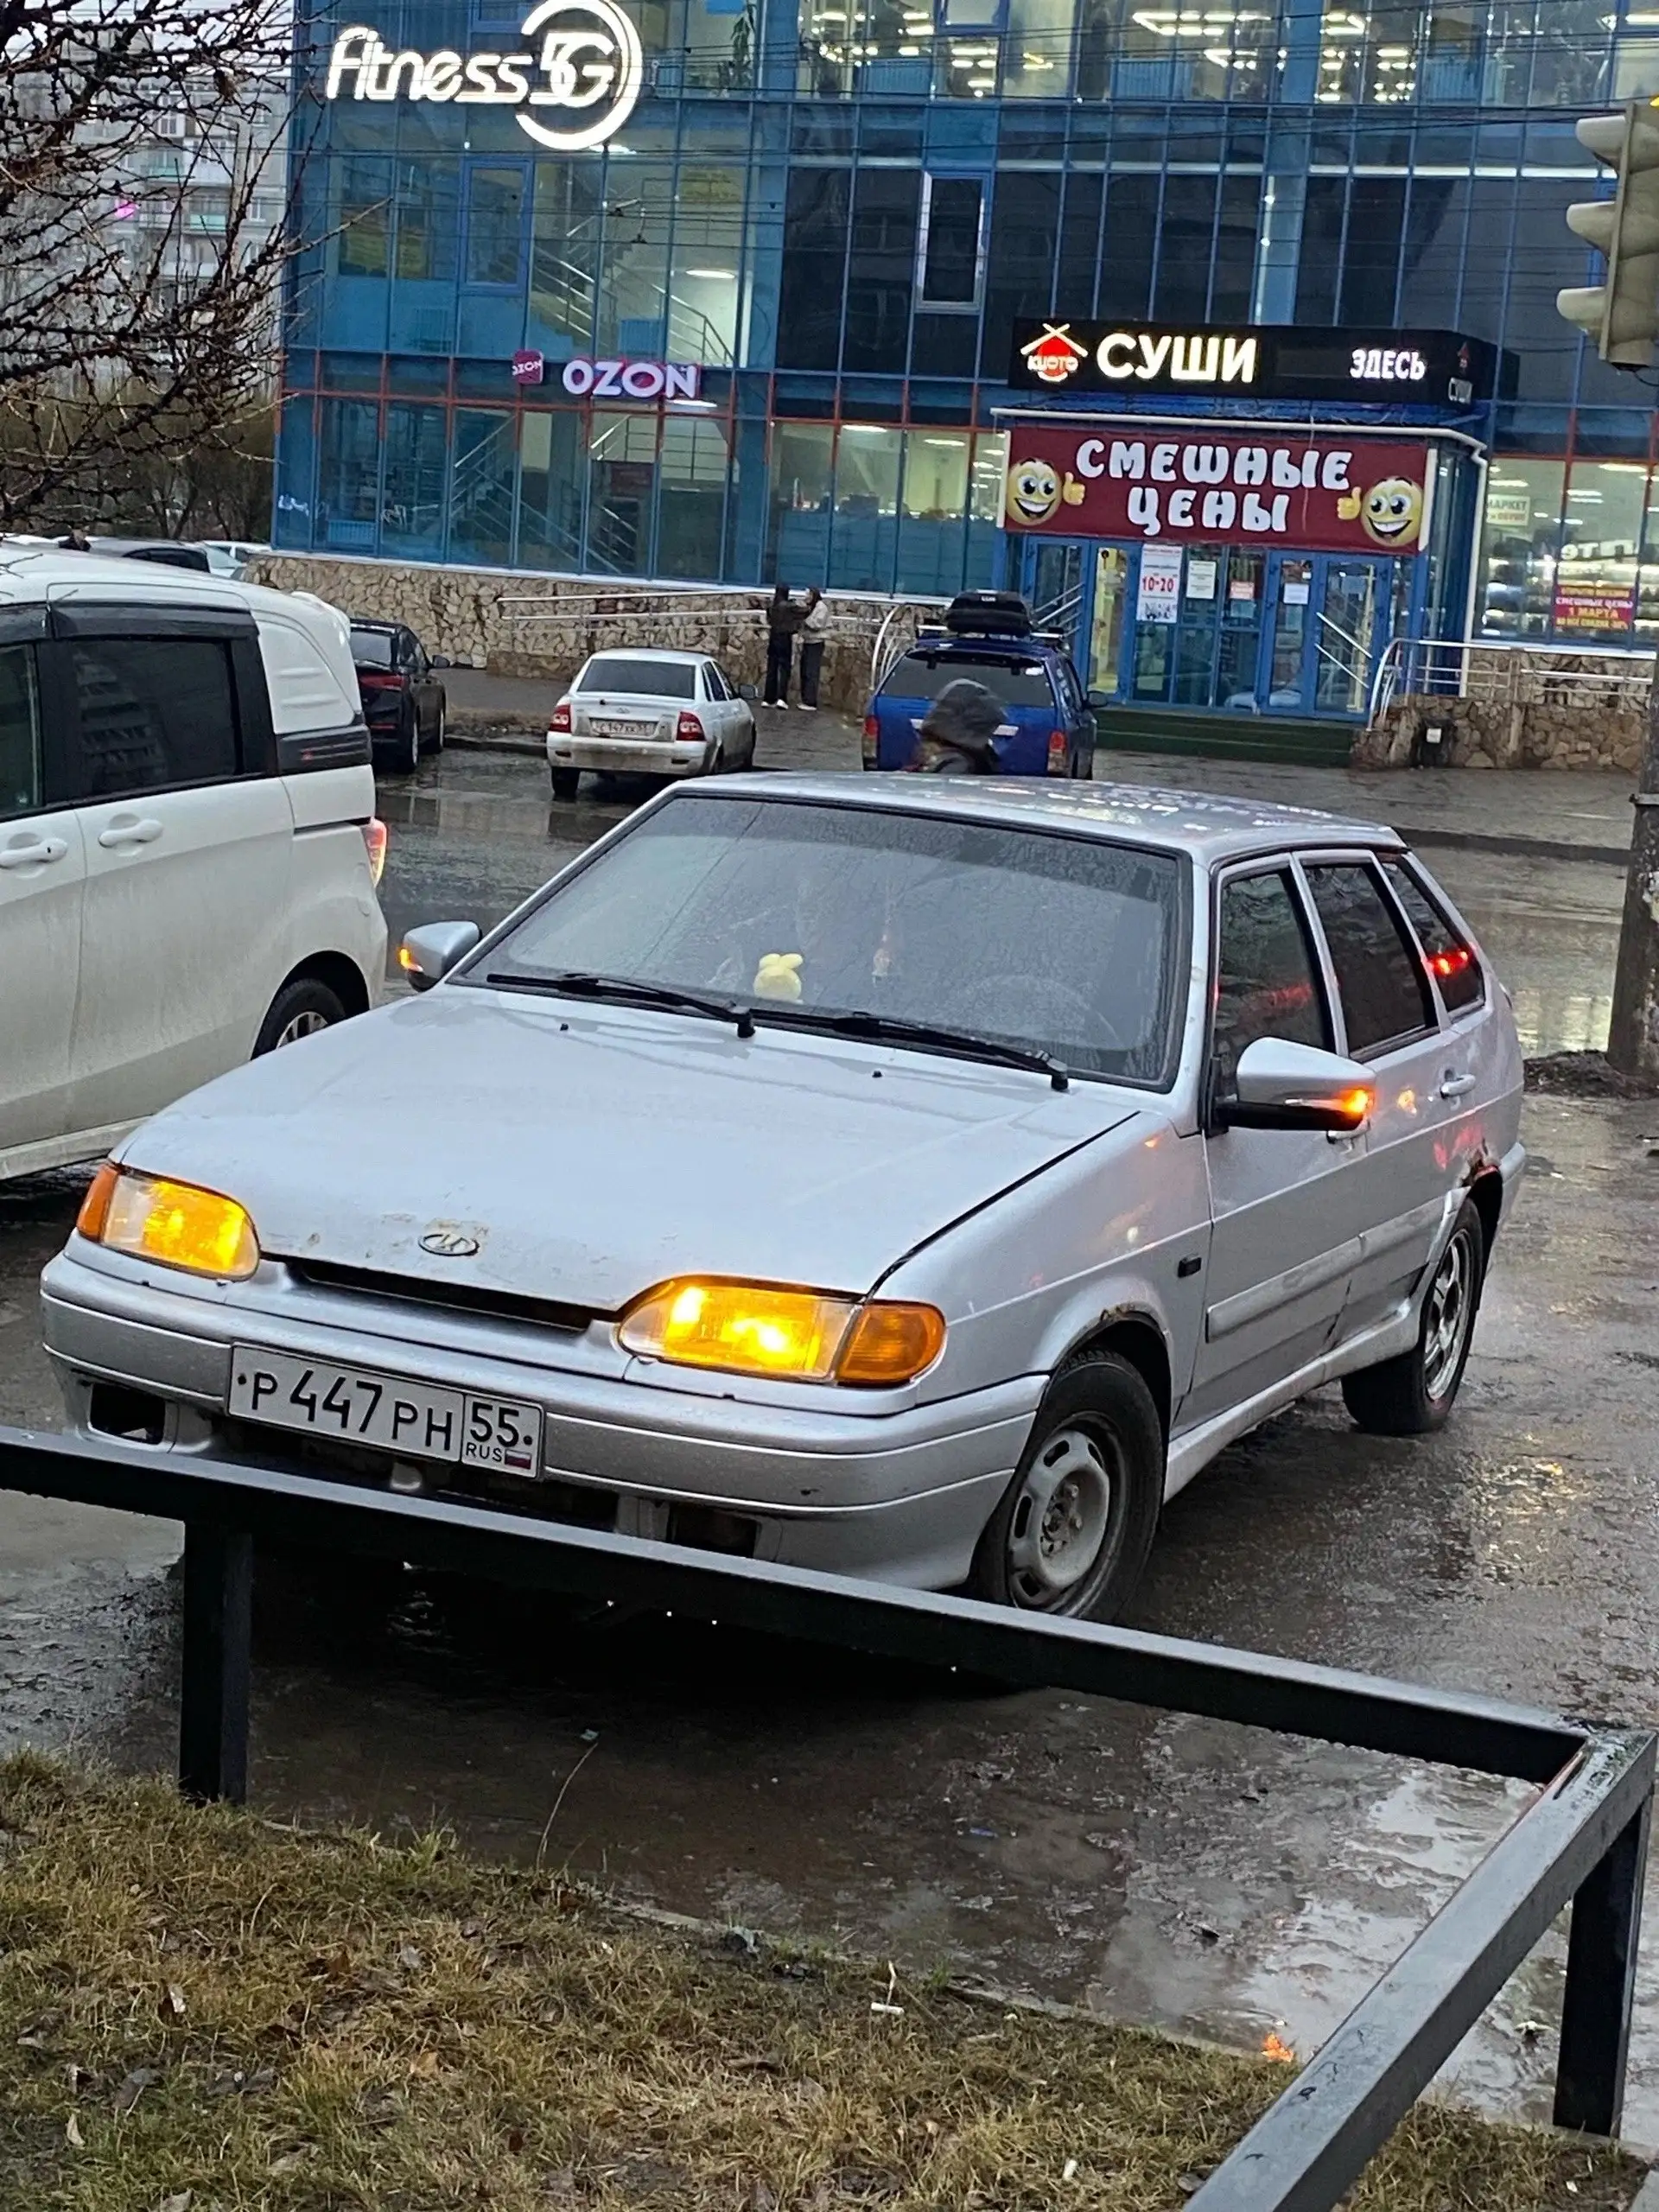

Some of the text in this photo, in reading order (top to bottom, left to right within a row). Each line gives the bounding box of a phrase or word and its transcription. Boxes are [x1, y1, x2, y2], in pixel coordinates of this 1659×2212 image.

[563, 359, 697, 398] OZON
[1096, 333, 1426, 383] СУШИ ЗДЕСЬ
[1076, 439, 1353, 489] СМЕШНЫЕ
[1128, 486, 1290, 536] ЦЕНЫ
[1141, 575, 1174, 593] 10-20
[1578, 607, 1619, 620] МАРТА
[470, 1402, 520, 1447] 55
[466, 1442, 503, 1462] RUS
